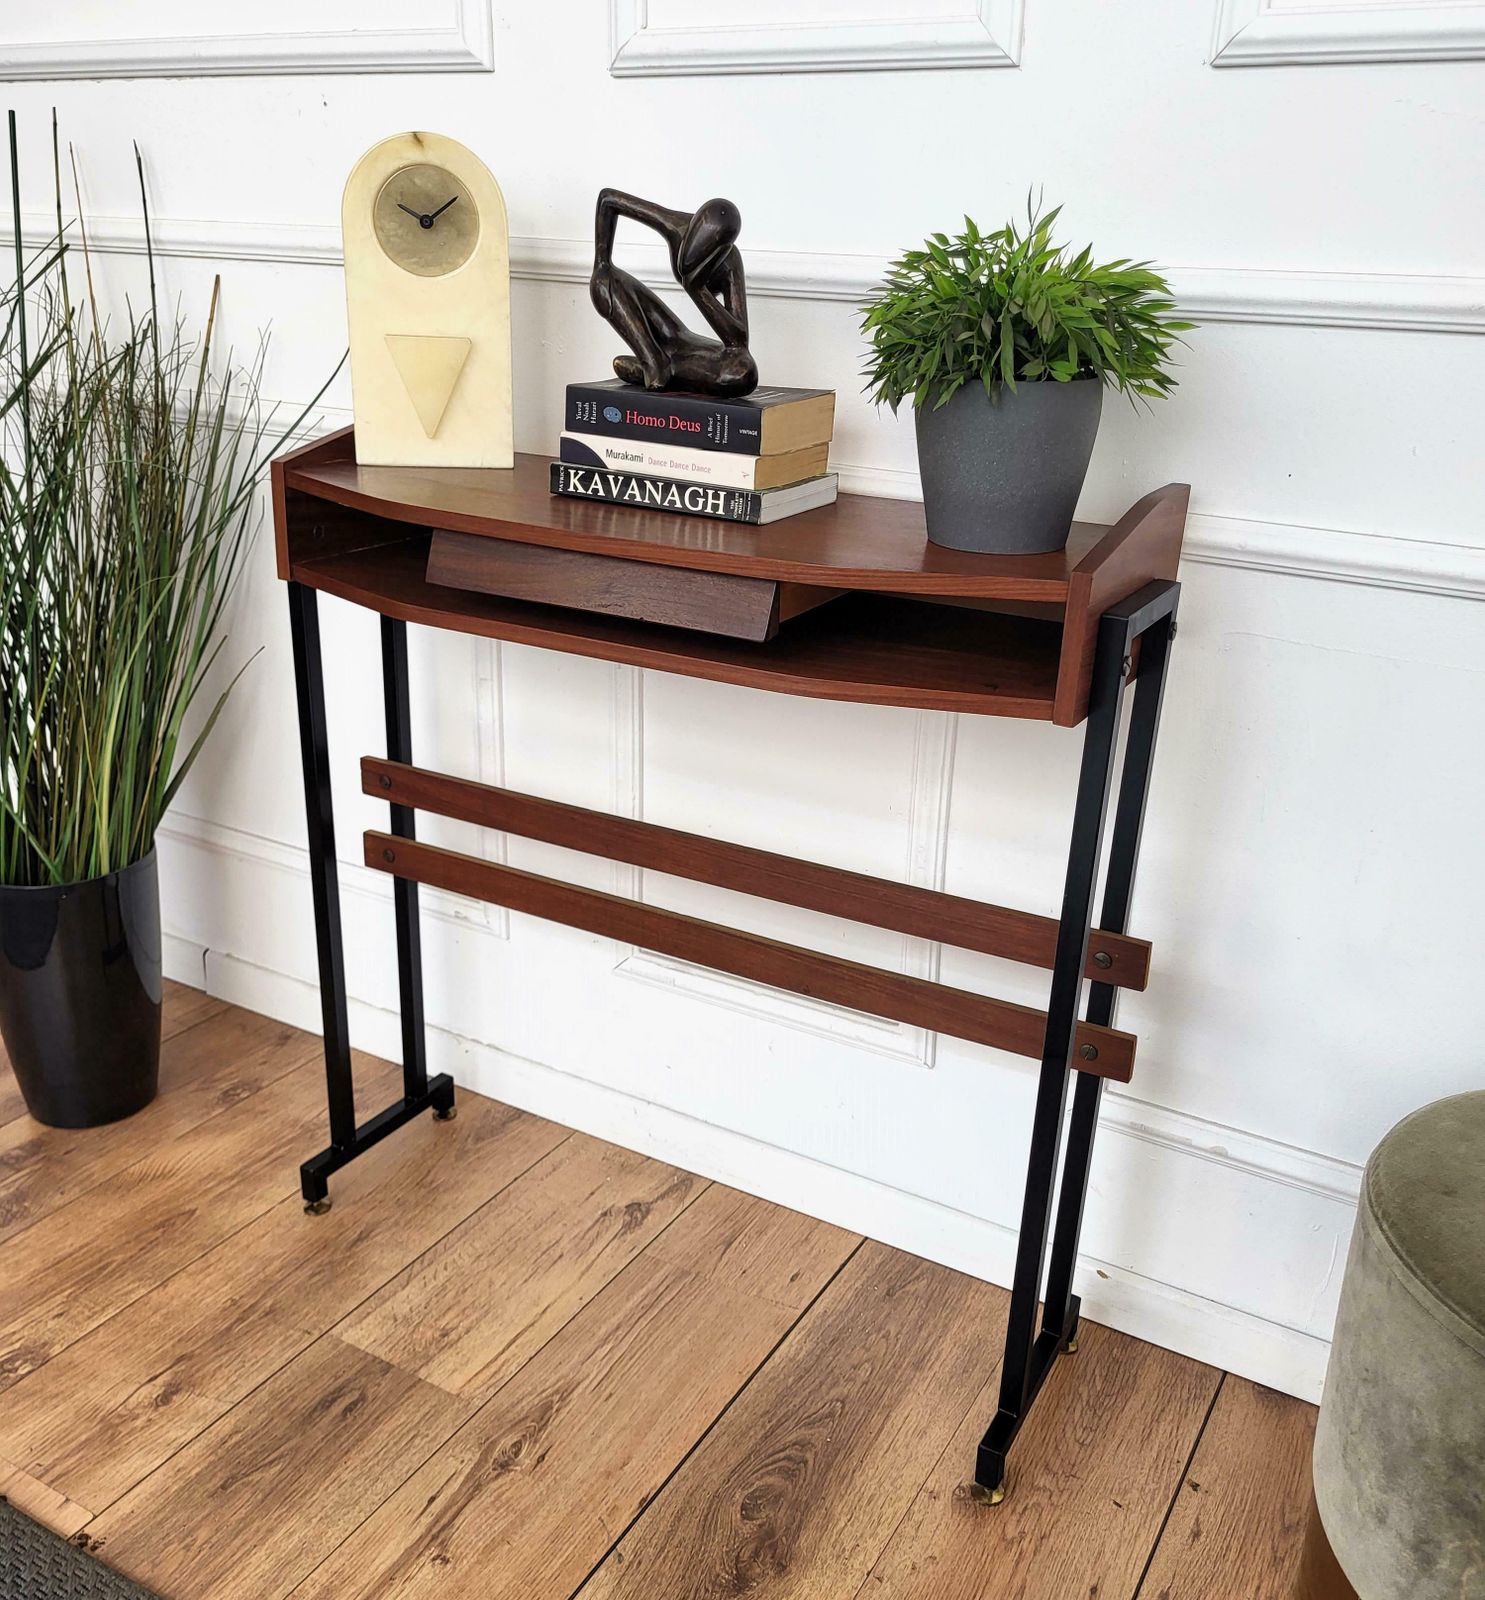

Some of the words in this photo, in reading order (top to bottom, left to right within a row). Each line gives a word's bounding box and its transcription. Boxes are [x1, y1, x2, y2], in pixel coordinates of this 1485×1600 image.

[626, 410, 666, 428] Homo
[669, 415, 702, 433] Deus
[739, 428, 758, 437] VINTAGE
[605, 448, 644, 463] Murakami
[648, 456, 668, 466] Dance
[669, 460, 690, 471] Dance
[691, 463, 712, 474] Dance
[567, 469, 727, 515] KAVANAGH
